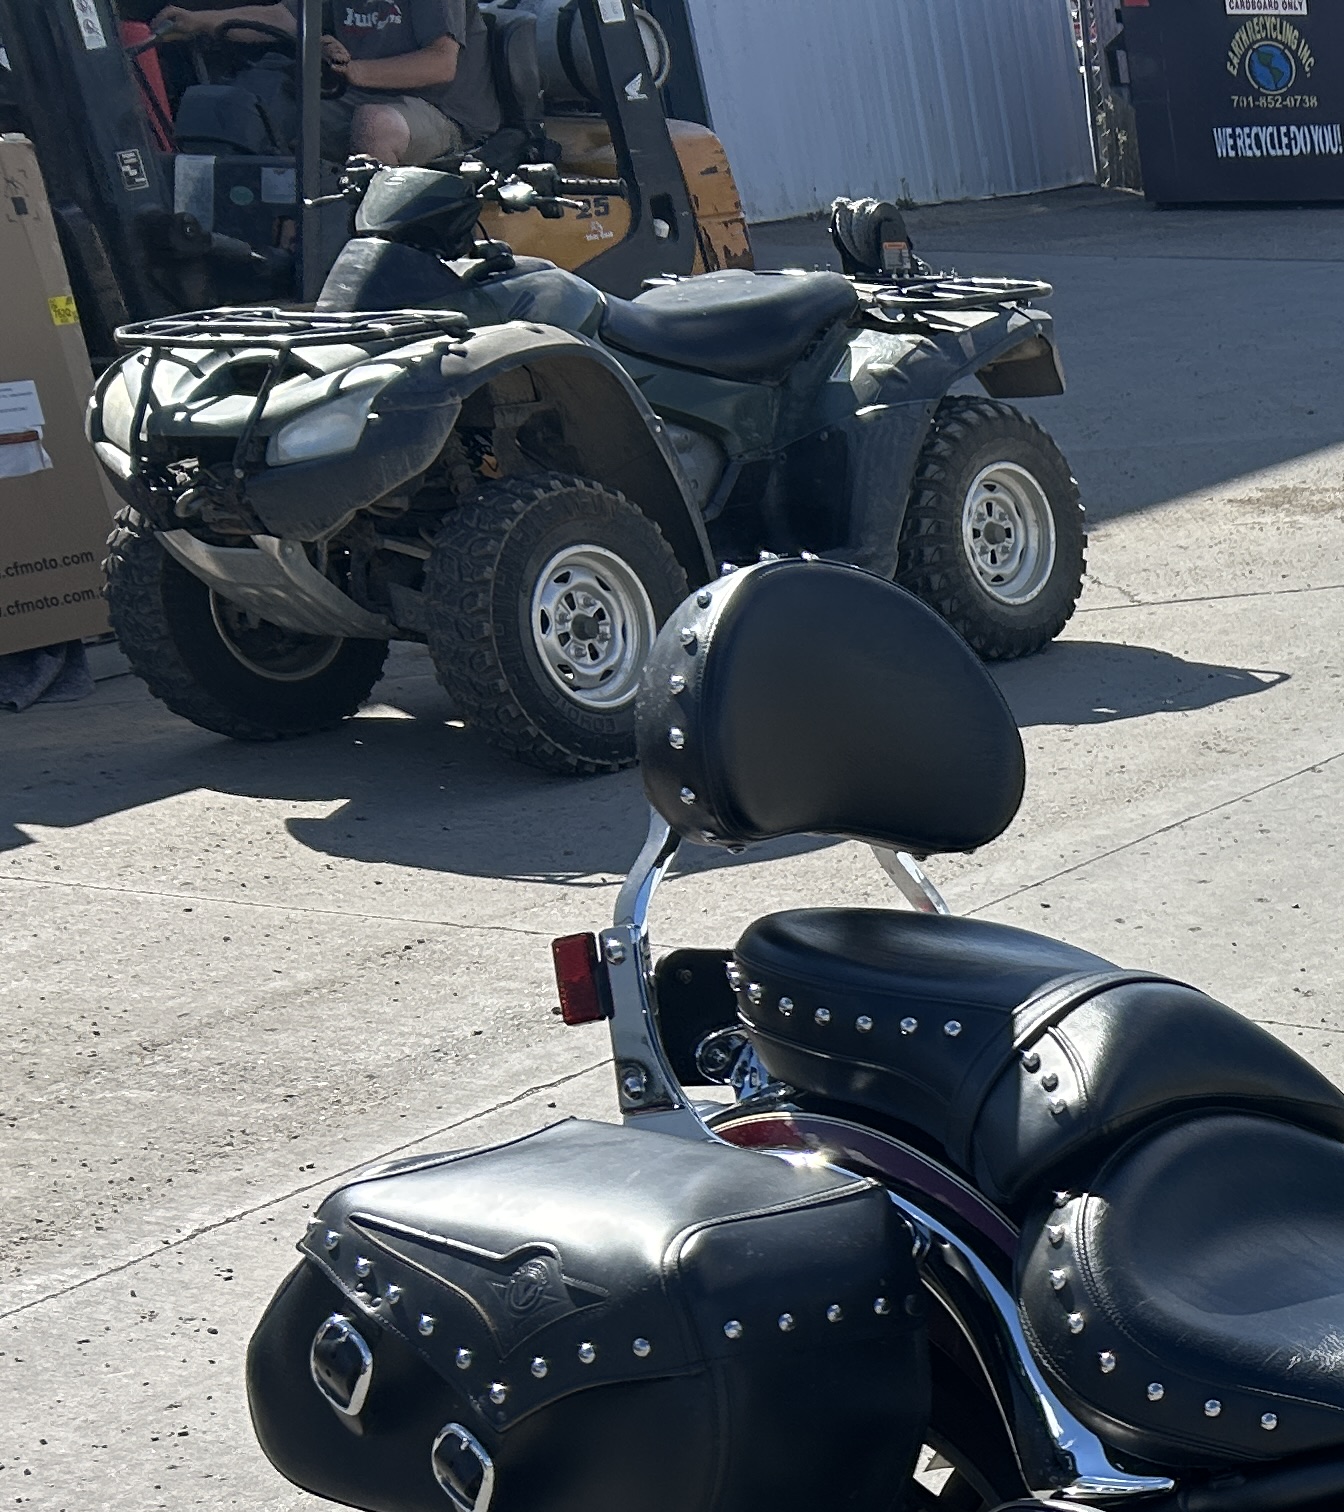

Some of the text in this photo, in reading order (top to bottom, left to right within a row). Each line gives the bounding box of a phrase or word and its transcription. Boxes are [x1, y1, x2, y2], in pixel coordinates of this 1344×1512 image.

[1228, 0, 1304, 10] CARDBOARD ONLY
[1227, 16, 1315, 79] EARTH RECYCLING INC.
[1231, 95, 1318, 108] 701-852-0738
[1213, 123, 1343, 158] WE RECYCLE DO YOU!
[0, 551, 95, 579] .cfmoto.com
